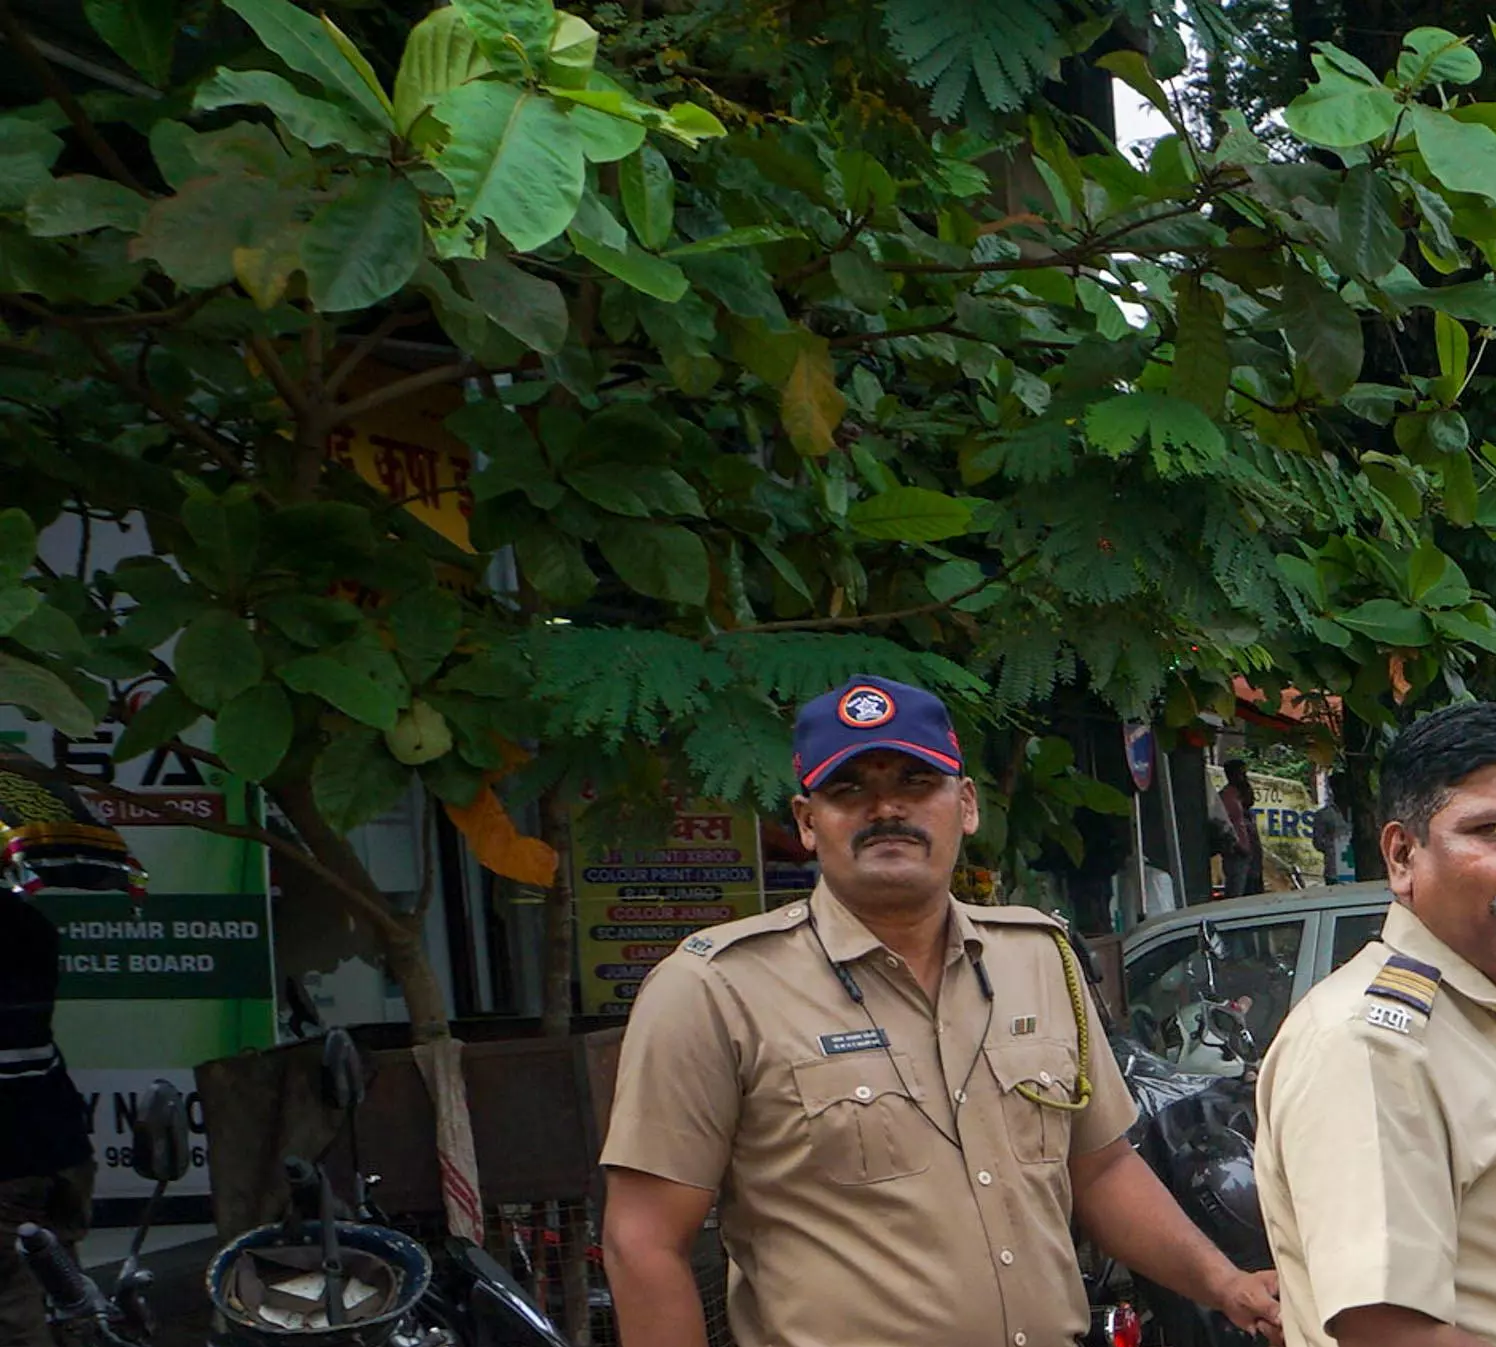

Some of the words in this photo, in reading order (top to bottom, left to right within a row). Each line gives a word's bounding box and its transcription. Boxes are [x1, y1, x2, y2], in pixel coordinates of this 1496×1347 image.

[587, 869, 648, 881] COLOUR
[652, 869, 691, 881] PRINT
[702, 869, 751, 881] XEROX
[614, 907, 675, 920] COLOUR
[678, 907, 731, 919] JUMBO
[69, 921, 165, 940] HDHMR
[172, 921, 259, 940] BOARD
[596, 926, 675, 939] SCANNING
[129, 955, 215, 972] BOARD
